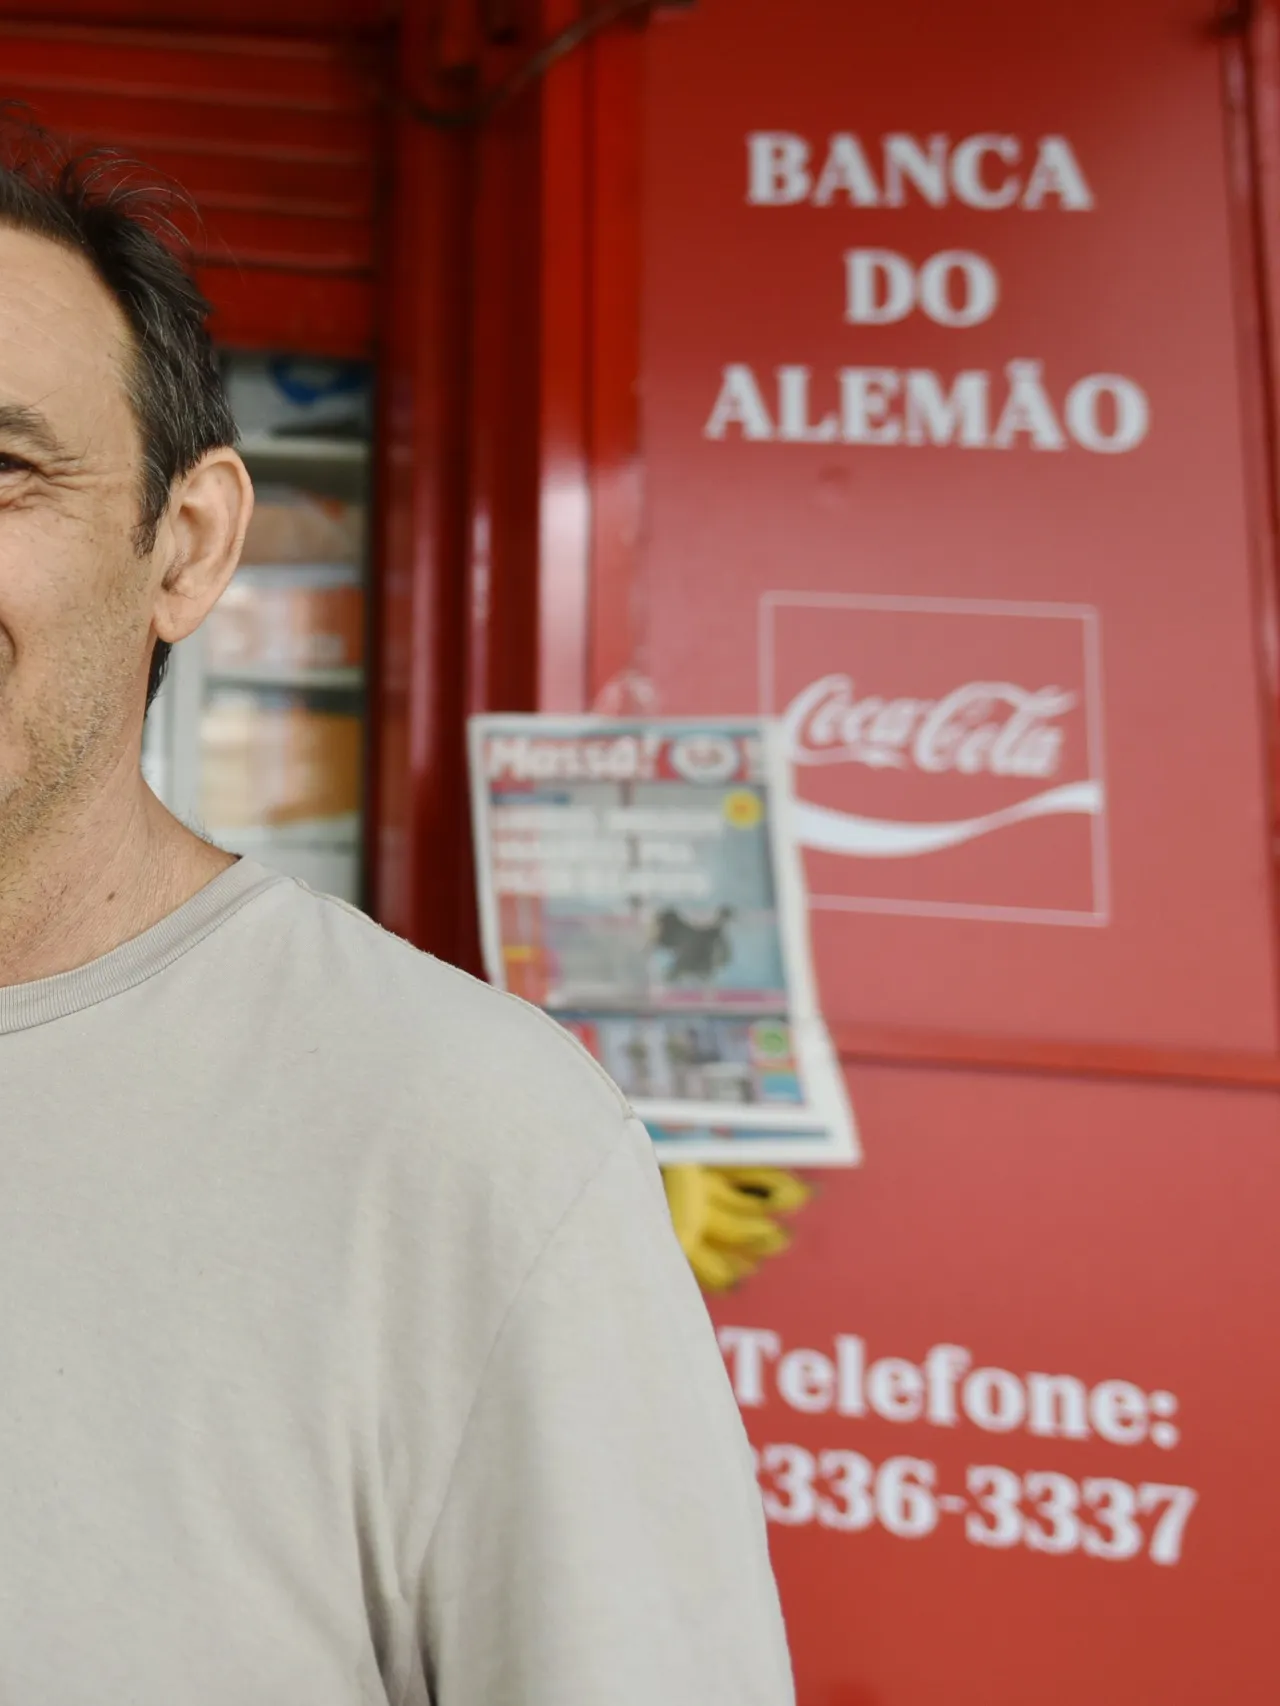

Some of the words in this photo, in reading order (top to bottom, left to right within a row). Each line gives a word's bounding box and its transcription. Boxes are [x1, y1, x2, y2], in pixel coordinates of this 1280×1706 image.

[746, 131, 1093, 210] BANCA
[845, 249, 998, 327] DO
[705, 359, 1149, 453] ALEMÃO
[720, 1325, 1178, 1448] Telefone:
[751, 1443, 1197, 1565] 336-3337
